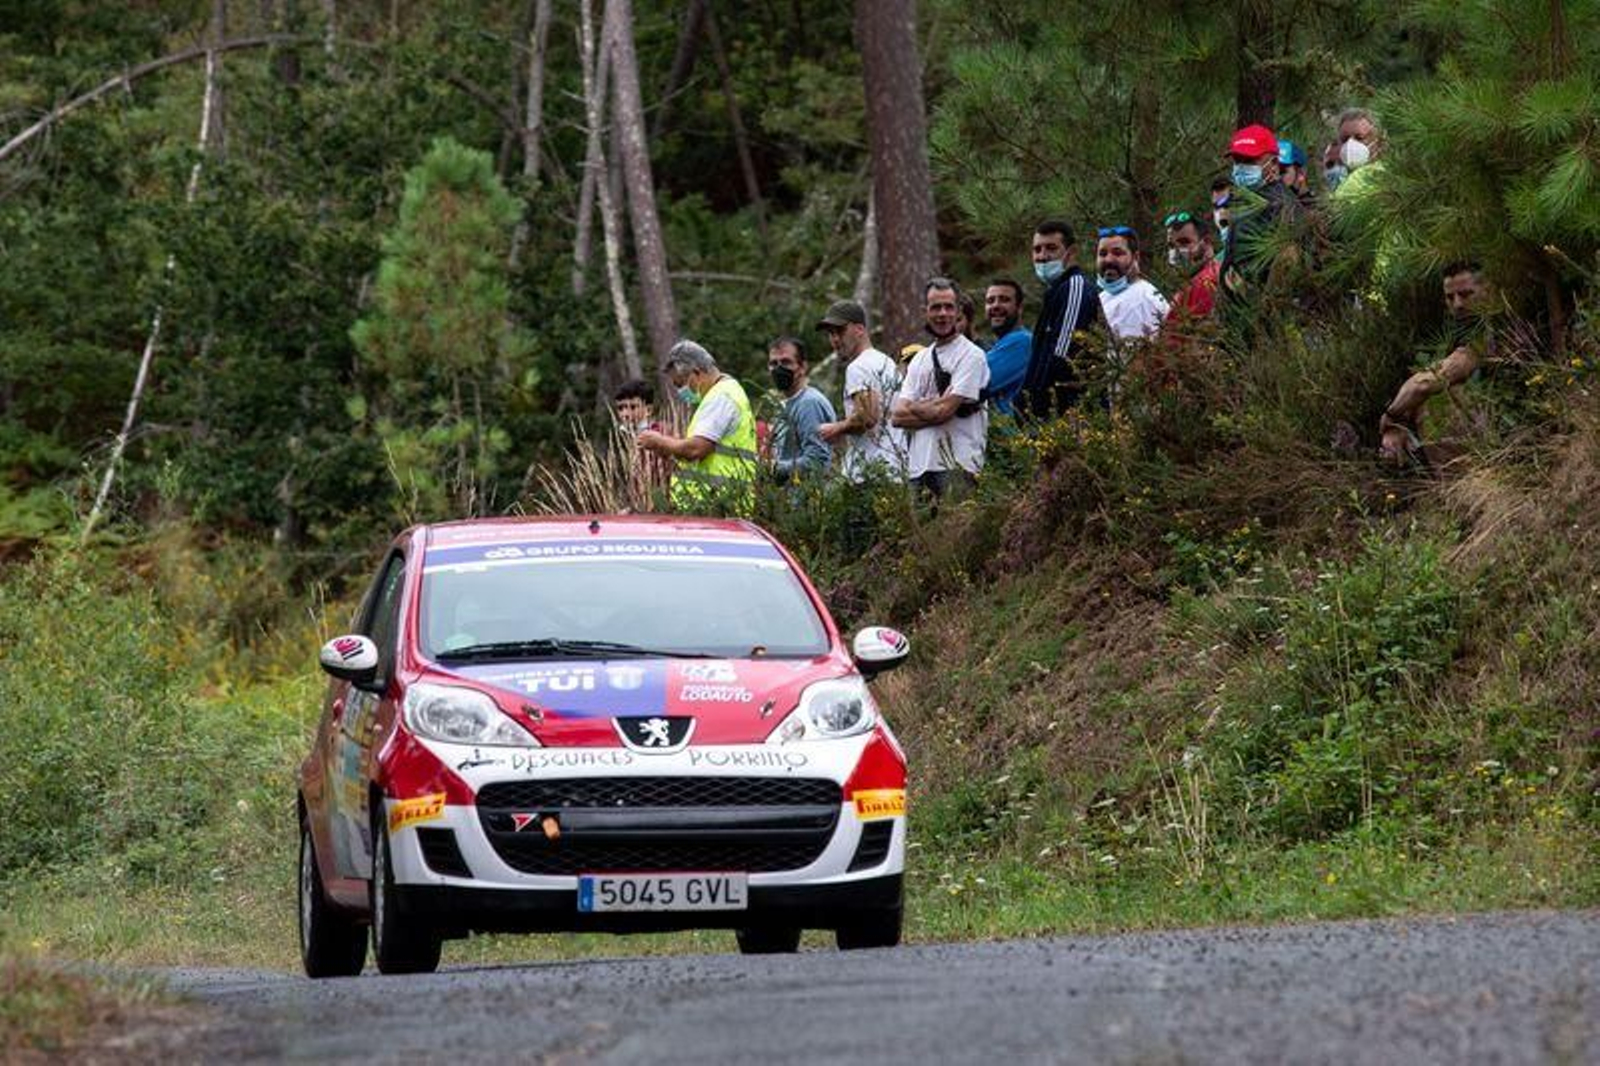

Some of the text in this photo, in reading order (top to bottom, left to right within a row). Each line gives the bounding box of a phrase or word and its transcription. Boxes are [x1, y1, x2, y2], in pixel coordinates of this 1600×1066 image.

[526, 545, 600, 556] GRUPO
[517, 675, 595, 692] TUI
[600, 878, 741, 905] 5045 GVL
